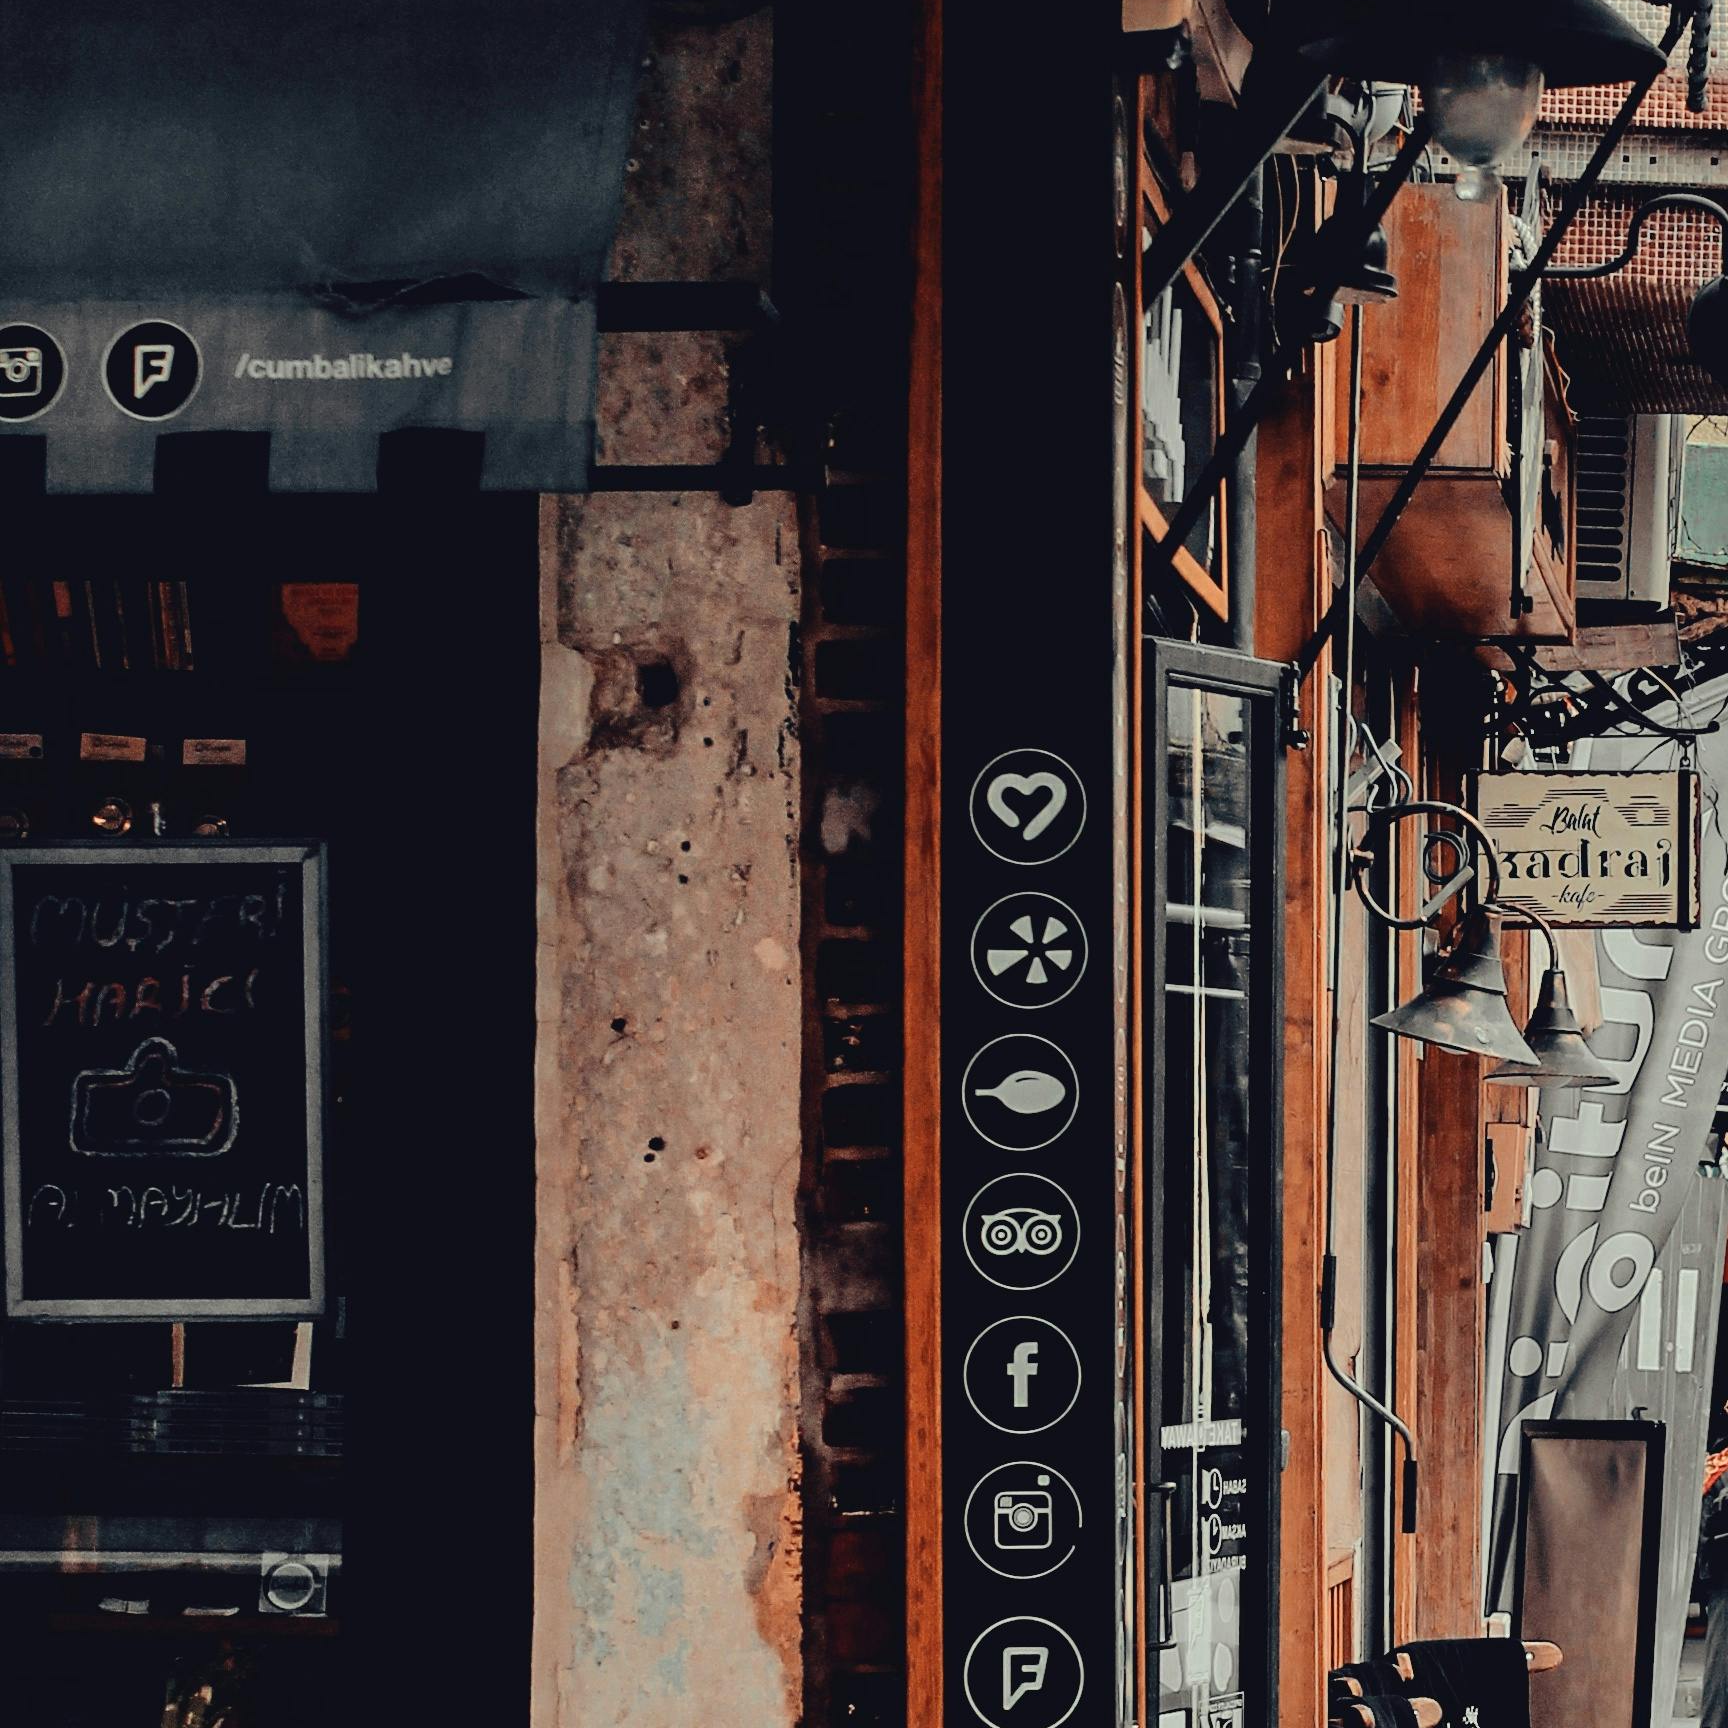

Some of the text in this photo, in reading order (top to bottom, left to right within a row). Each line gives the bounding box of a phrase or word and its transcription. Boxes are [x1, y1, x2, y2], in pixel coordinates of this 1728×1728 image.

[234, 352, 454, 381] /cumbalikahve
[1539, 803, 1602, 839] Balat
[1628, 1123, 1681, 1214] beIN
[1660, 977, 1725, 1108] MEDIA
